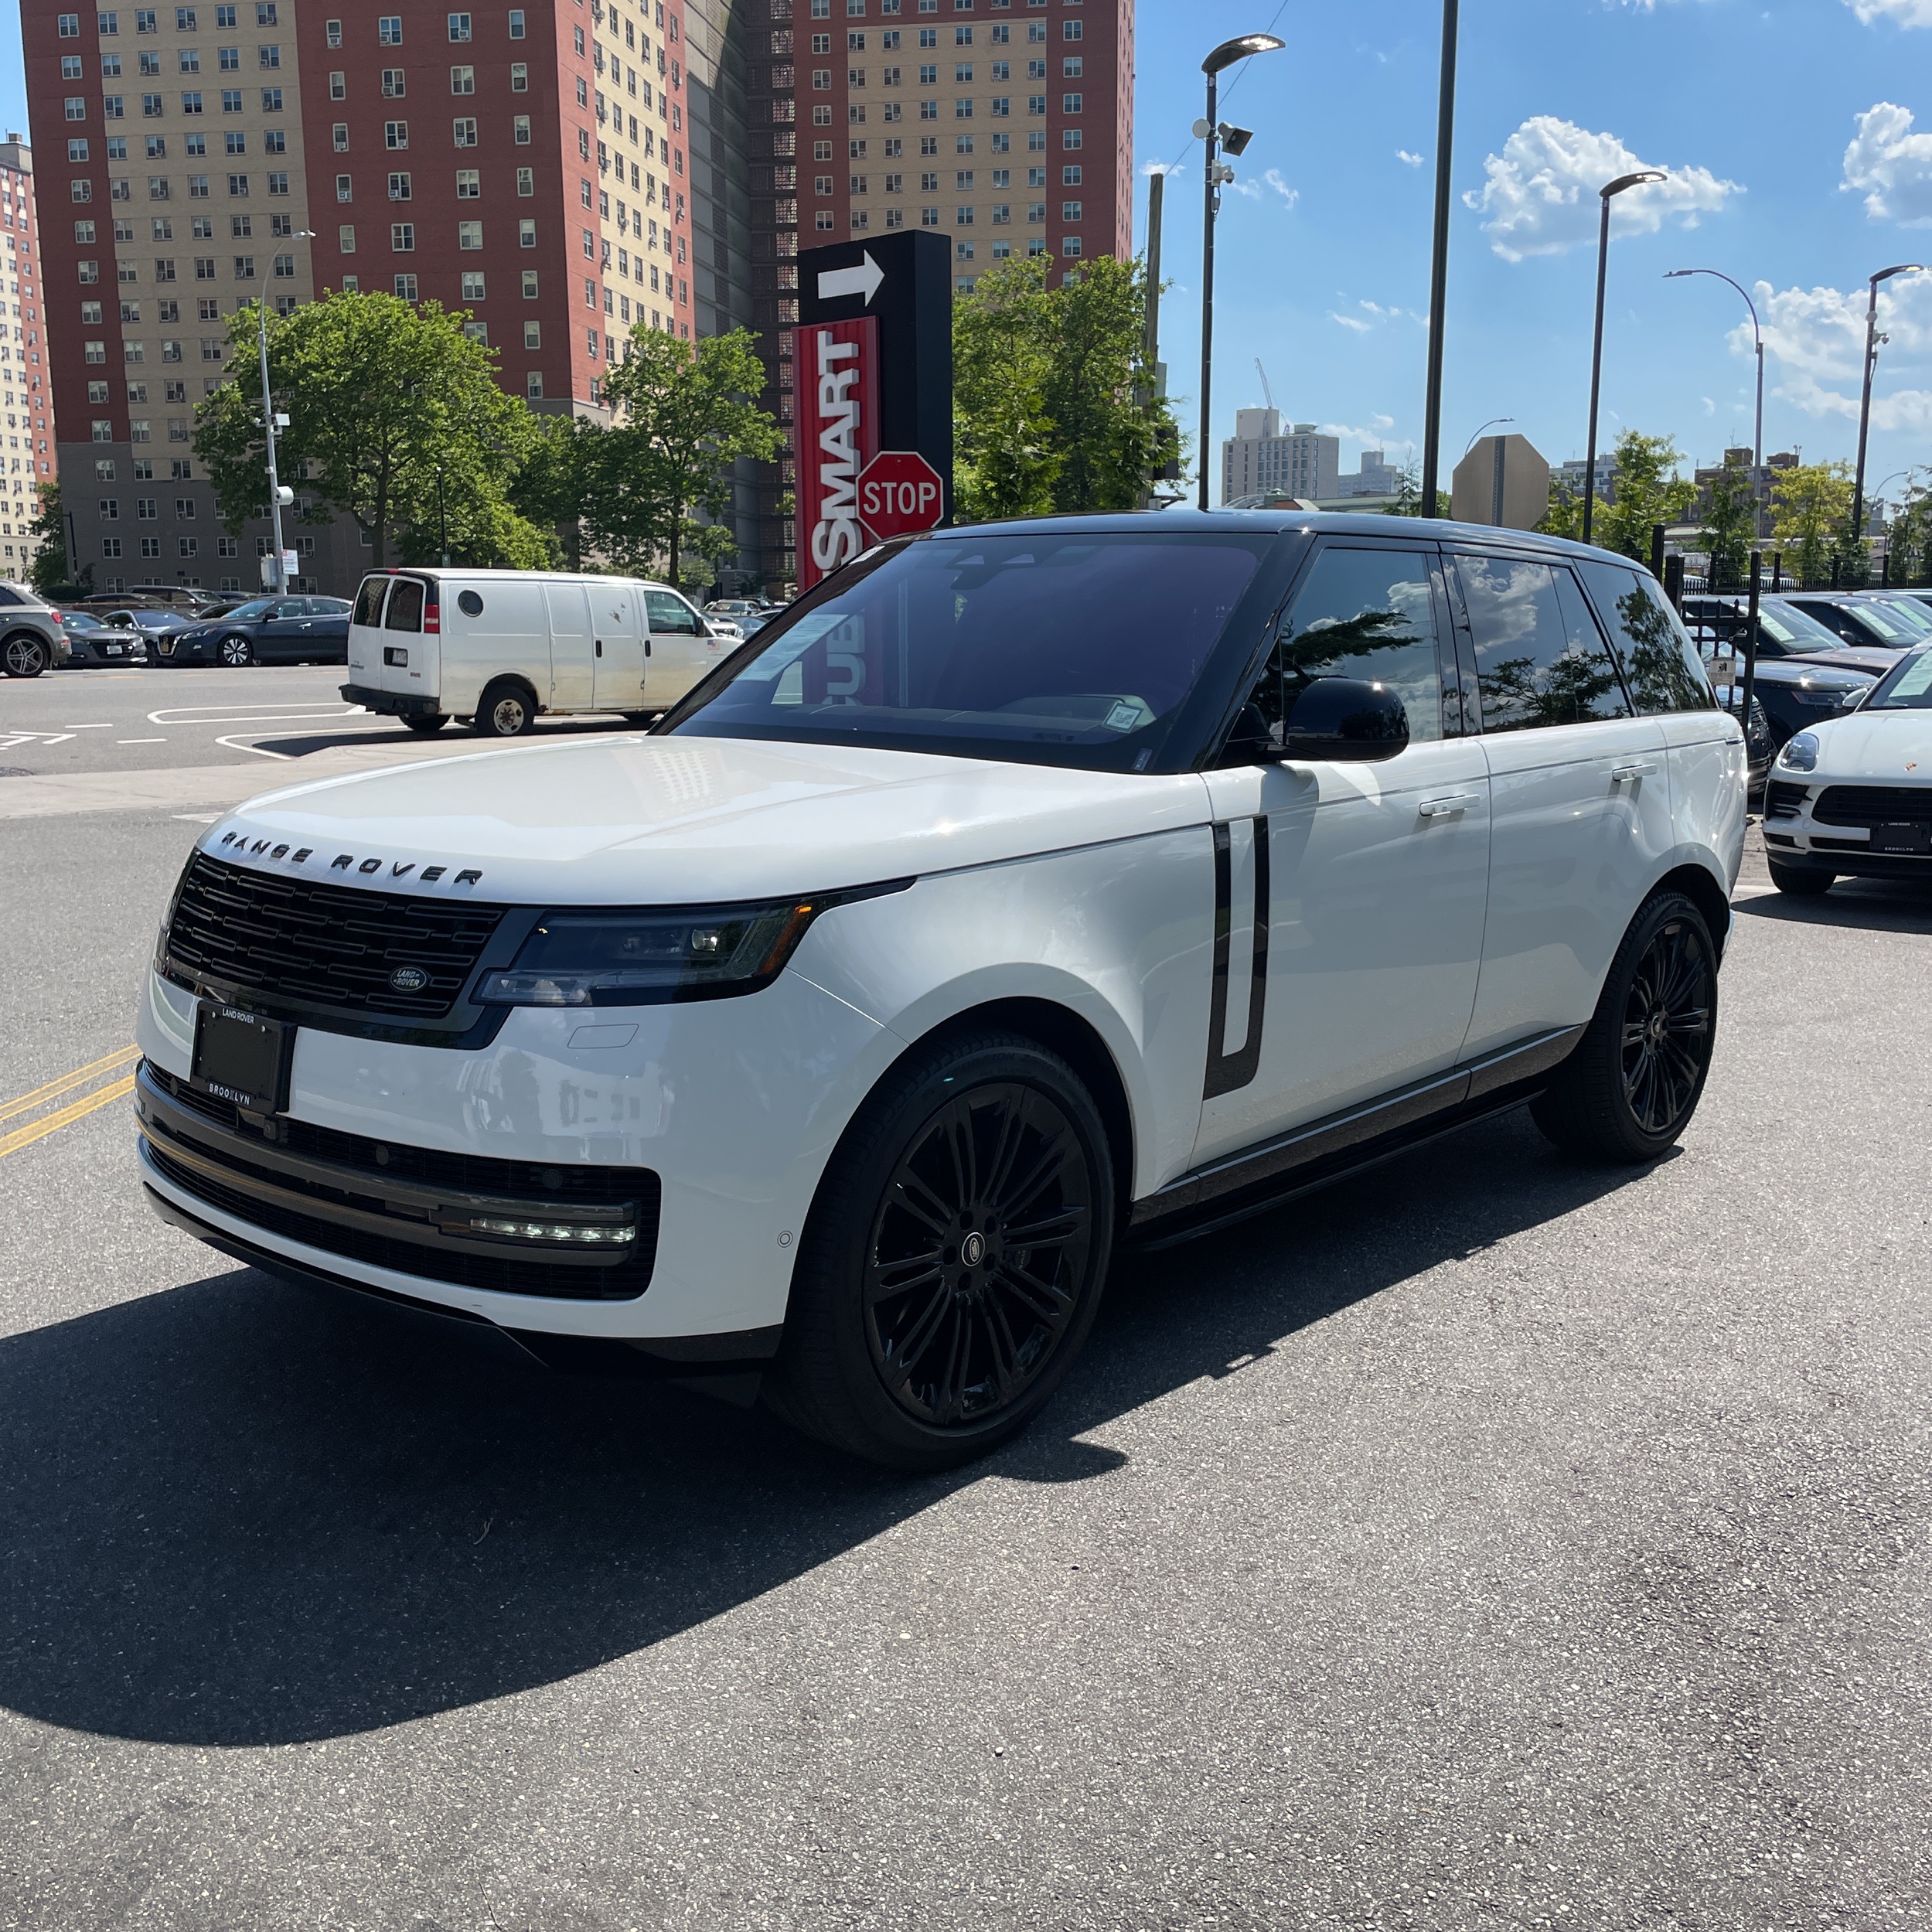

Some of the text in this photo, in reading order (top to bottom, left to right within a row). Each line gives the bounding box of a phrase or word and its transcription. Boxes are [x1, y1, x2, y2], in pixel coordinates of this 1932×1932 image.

[863, 482, 936, 515] STOP
[221, 831, 484, 885] RANGE ROVER
[222, 1007, 255, 1025] LAND ROVER
[209, 1083, 250, 1106] BROOKLYN
